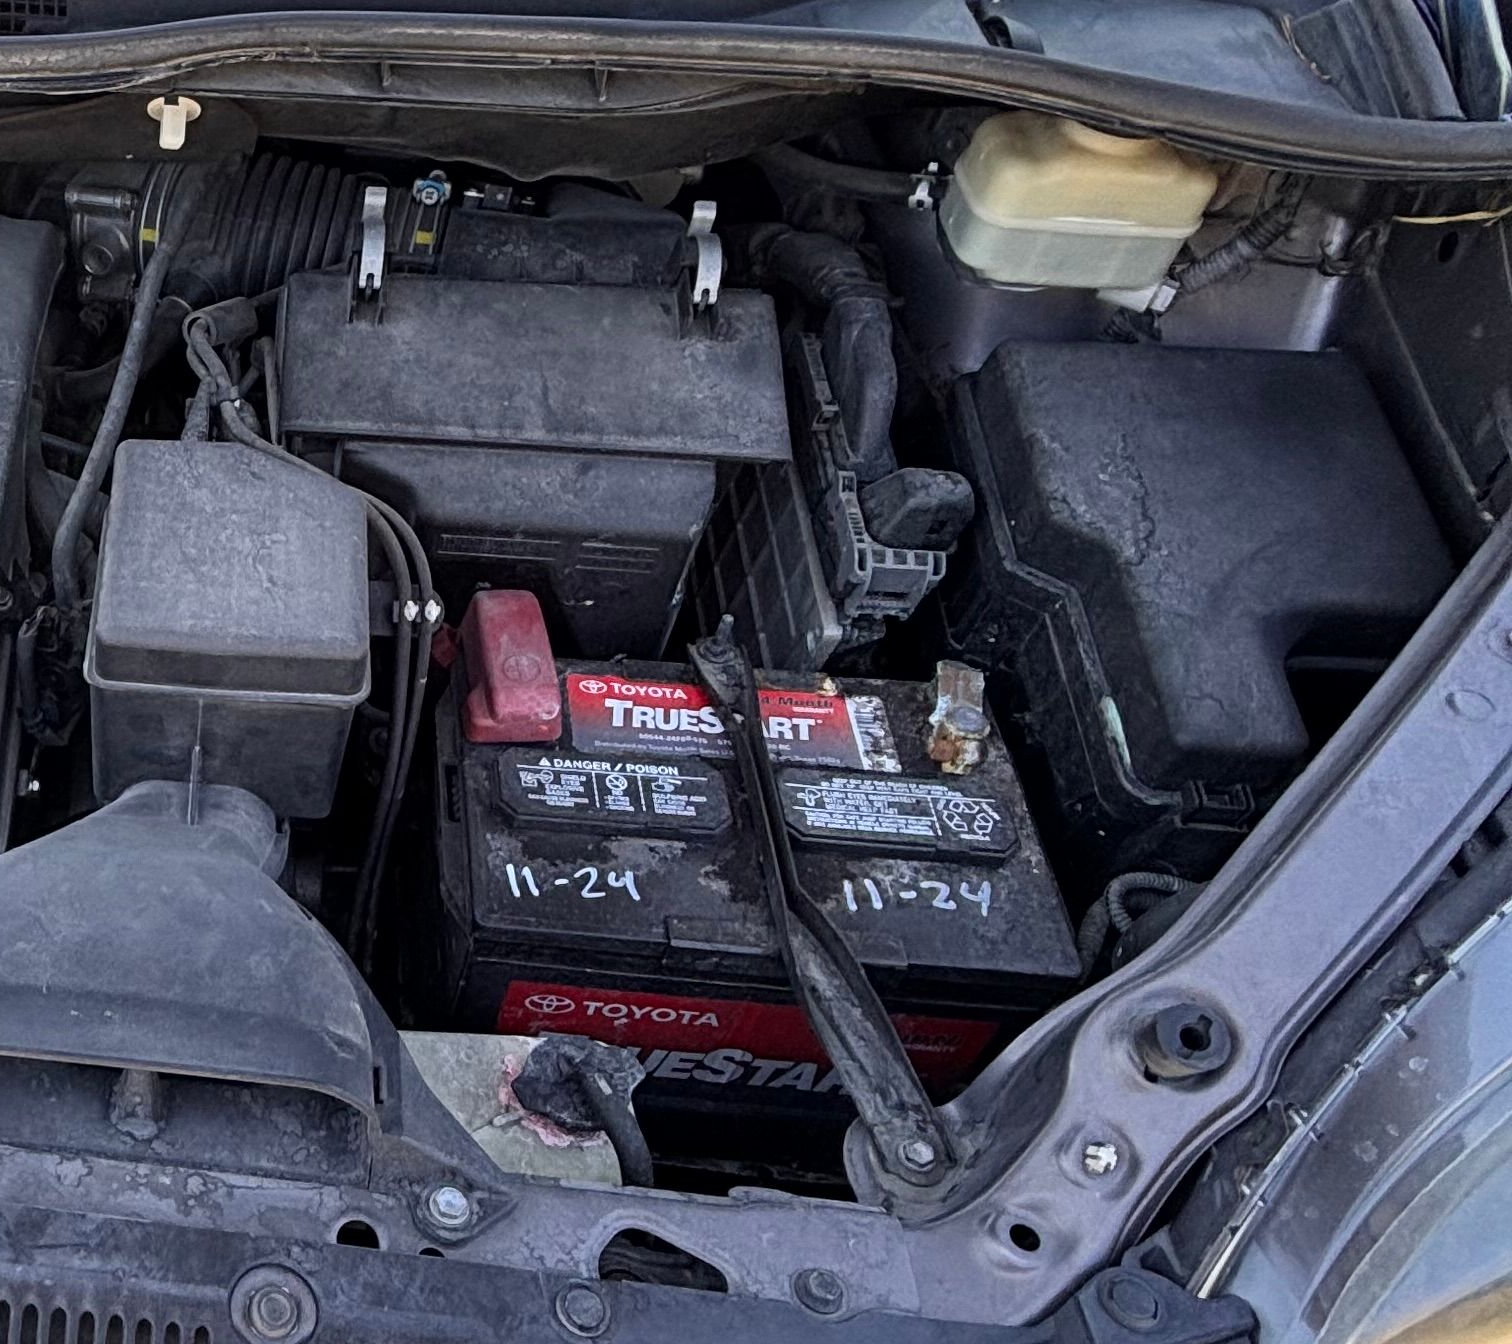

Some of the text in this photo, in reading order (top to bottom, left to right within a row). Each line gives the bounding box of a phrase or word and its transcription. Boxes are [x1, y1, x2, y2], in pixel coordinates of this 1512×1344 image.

[610, 682, 688, 700] TOYOTA
[553, 758, 612, 772] DANGER
[625, 763, 679, 776] POISON
[506, 863, 641, 901] 11-24
[842, 878, 992, 916] 11-24
[582, 999, 720, 1028] TOYOTA
